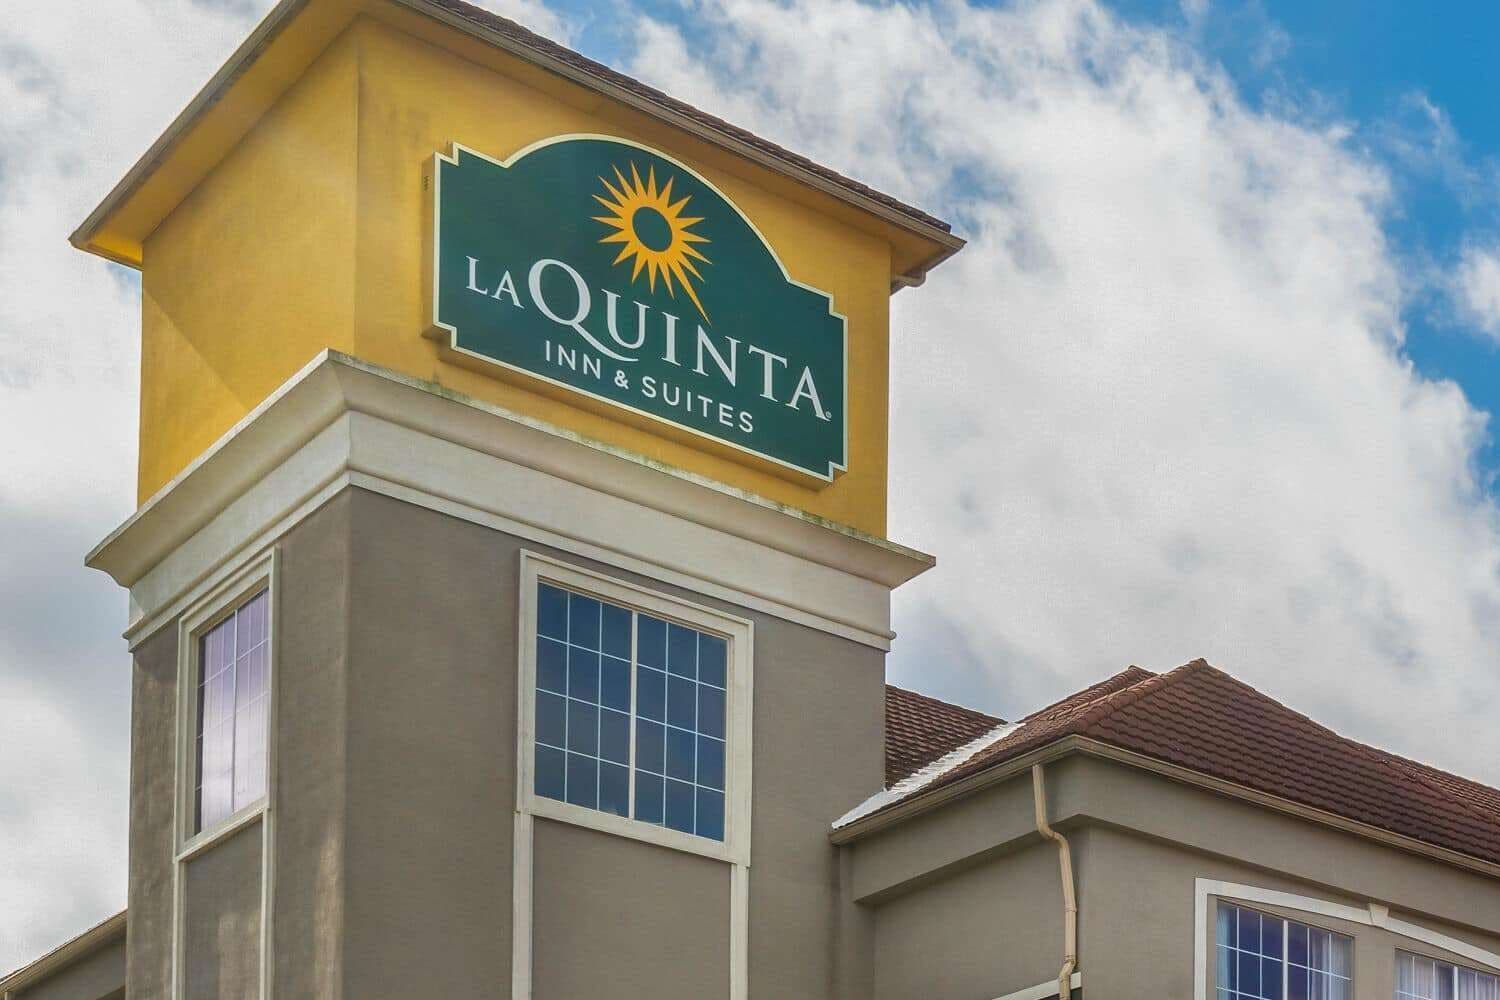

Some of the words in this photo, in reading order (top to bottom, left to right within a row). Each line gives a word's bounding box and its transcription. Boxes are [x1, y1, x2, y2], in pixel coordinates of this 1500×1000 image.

[528, 258, 831, 422] QUINTA
[545, 340, 601, 380] INN
[614, 369, 629, 390] &
[641, 375, 754, 434] SUITES
